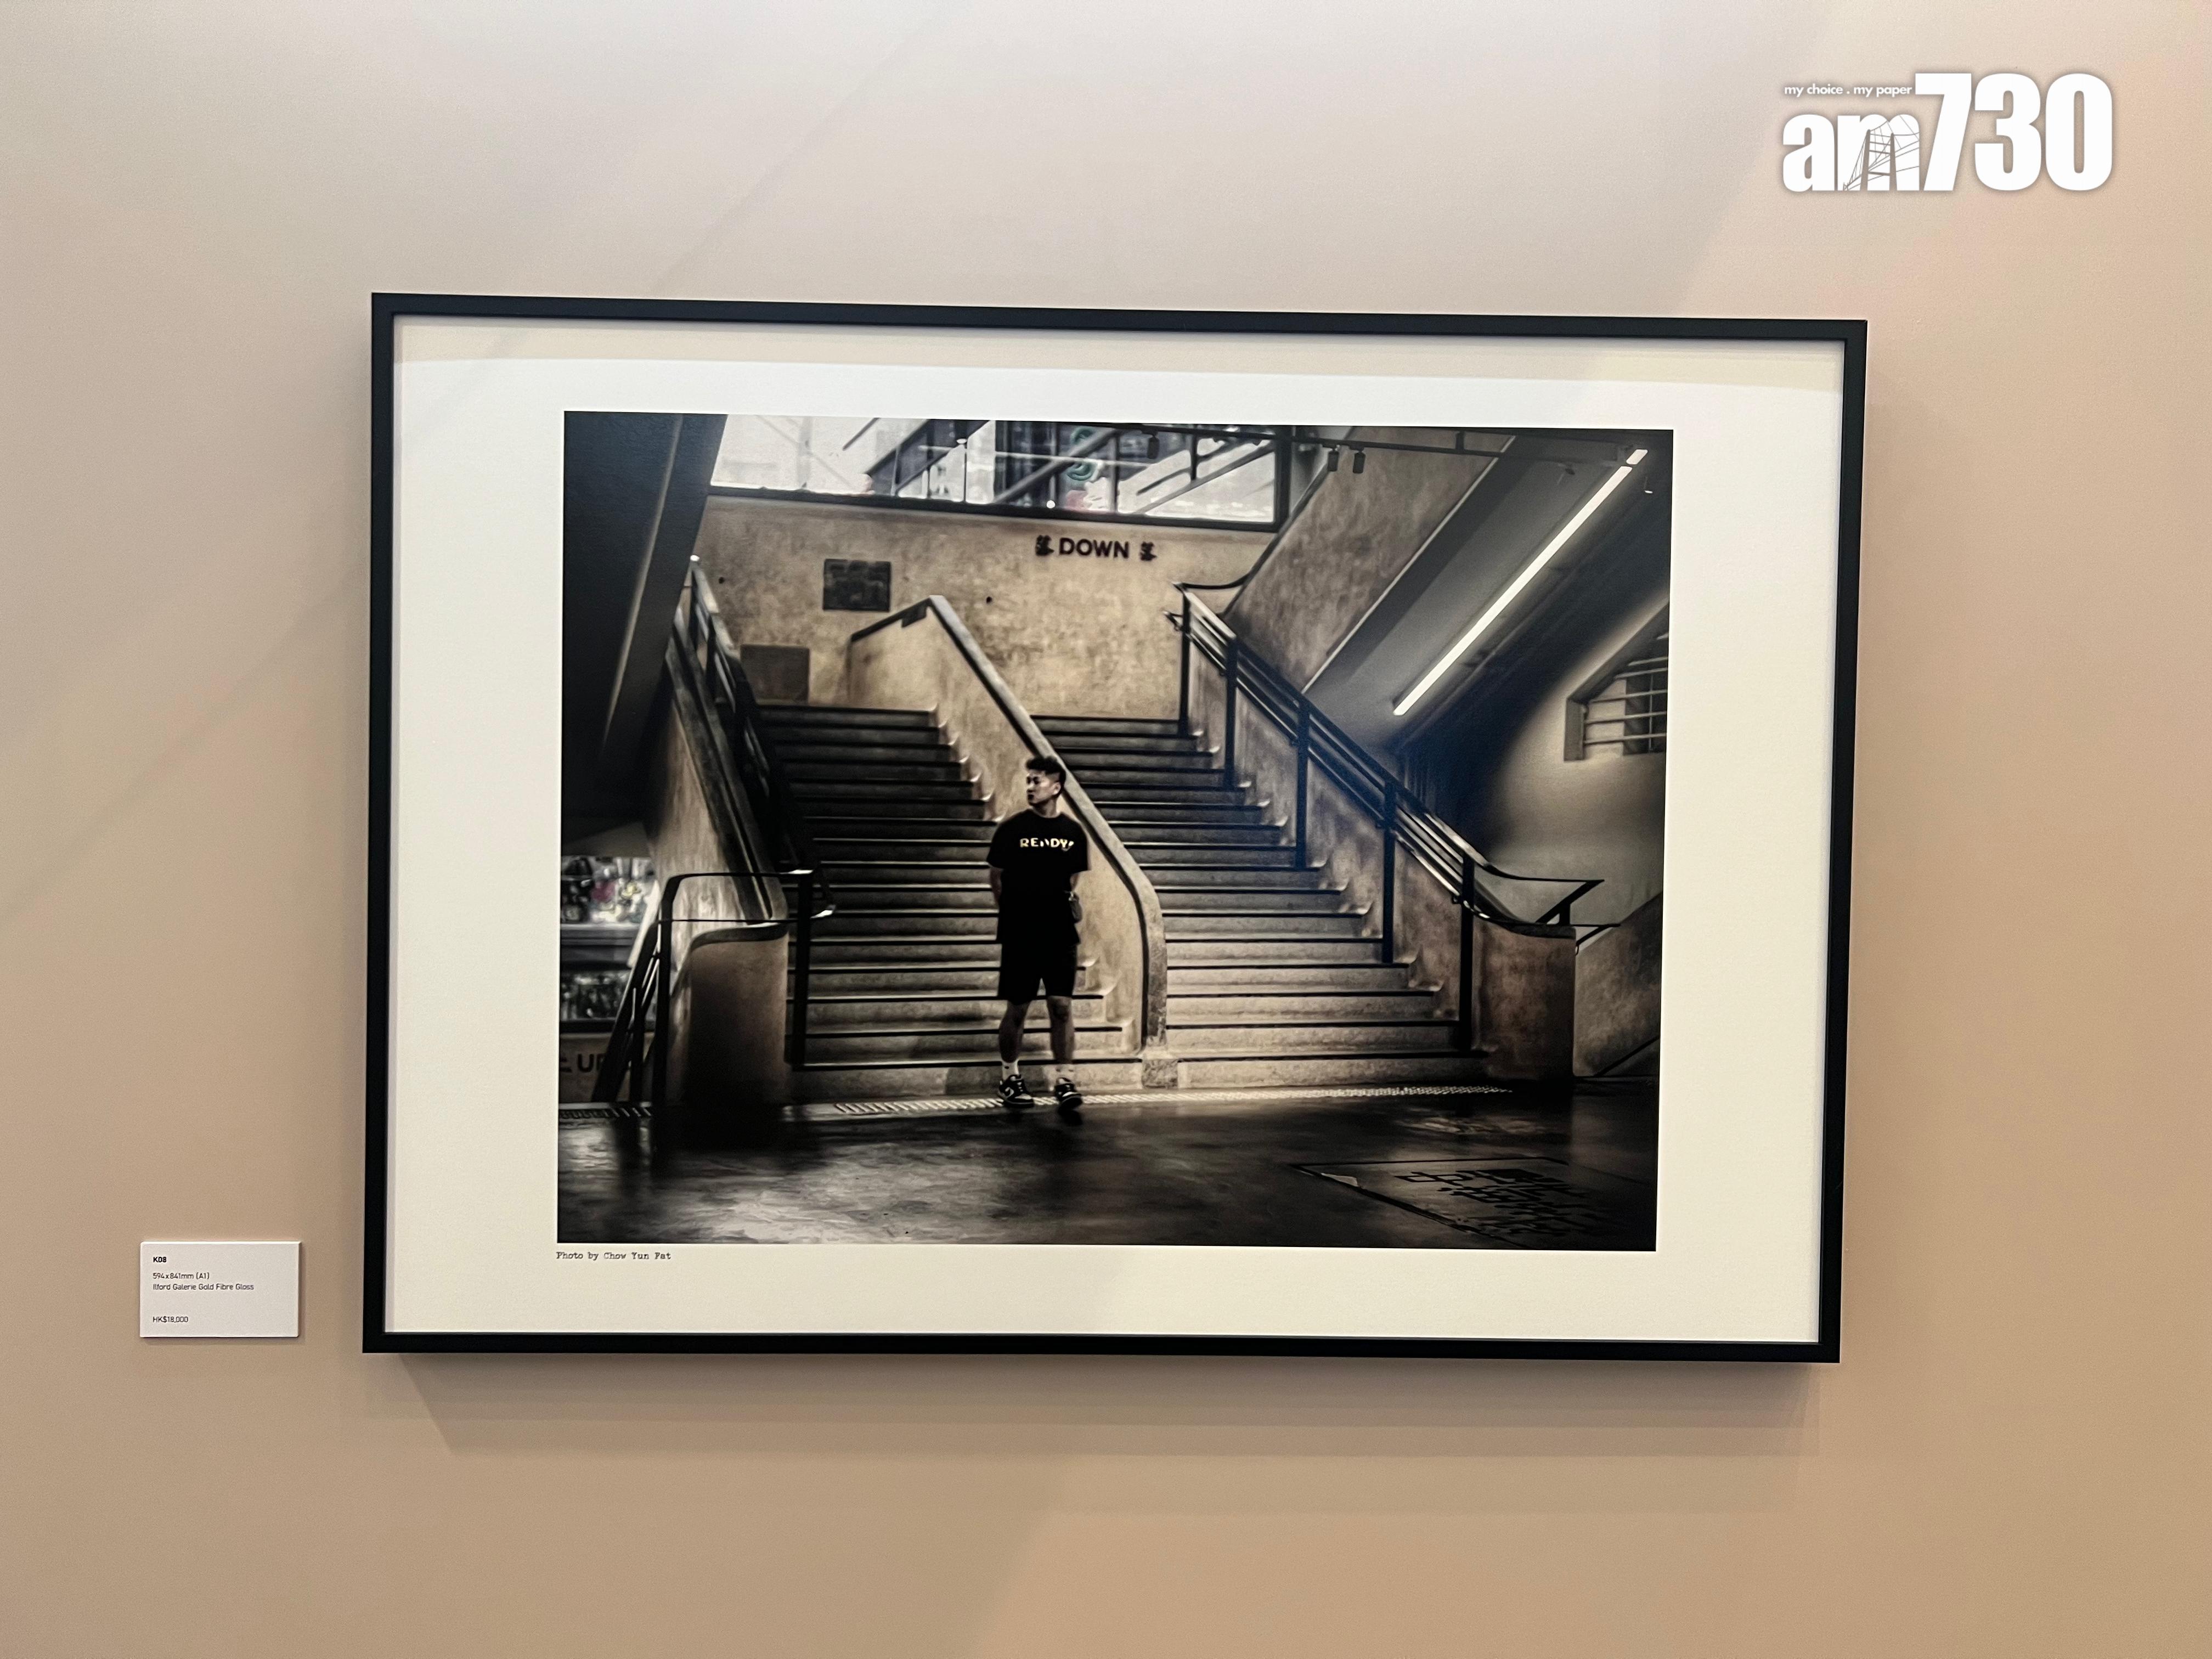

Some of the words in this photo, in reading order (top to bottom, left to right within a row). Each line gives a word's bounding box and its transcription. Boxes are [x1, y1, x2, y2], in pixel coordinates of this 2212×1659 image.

[1058, 537, 1130, 559] DOWN
[556, 1251, 583, 1260] Photo
[588, 1251, 599, 1261] by
[603, 1251, 627, 1260] Chow
[631, 1251, 650, 1260] Yun
